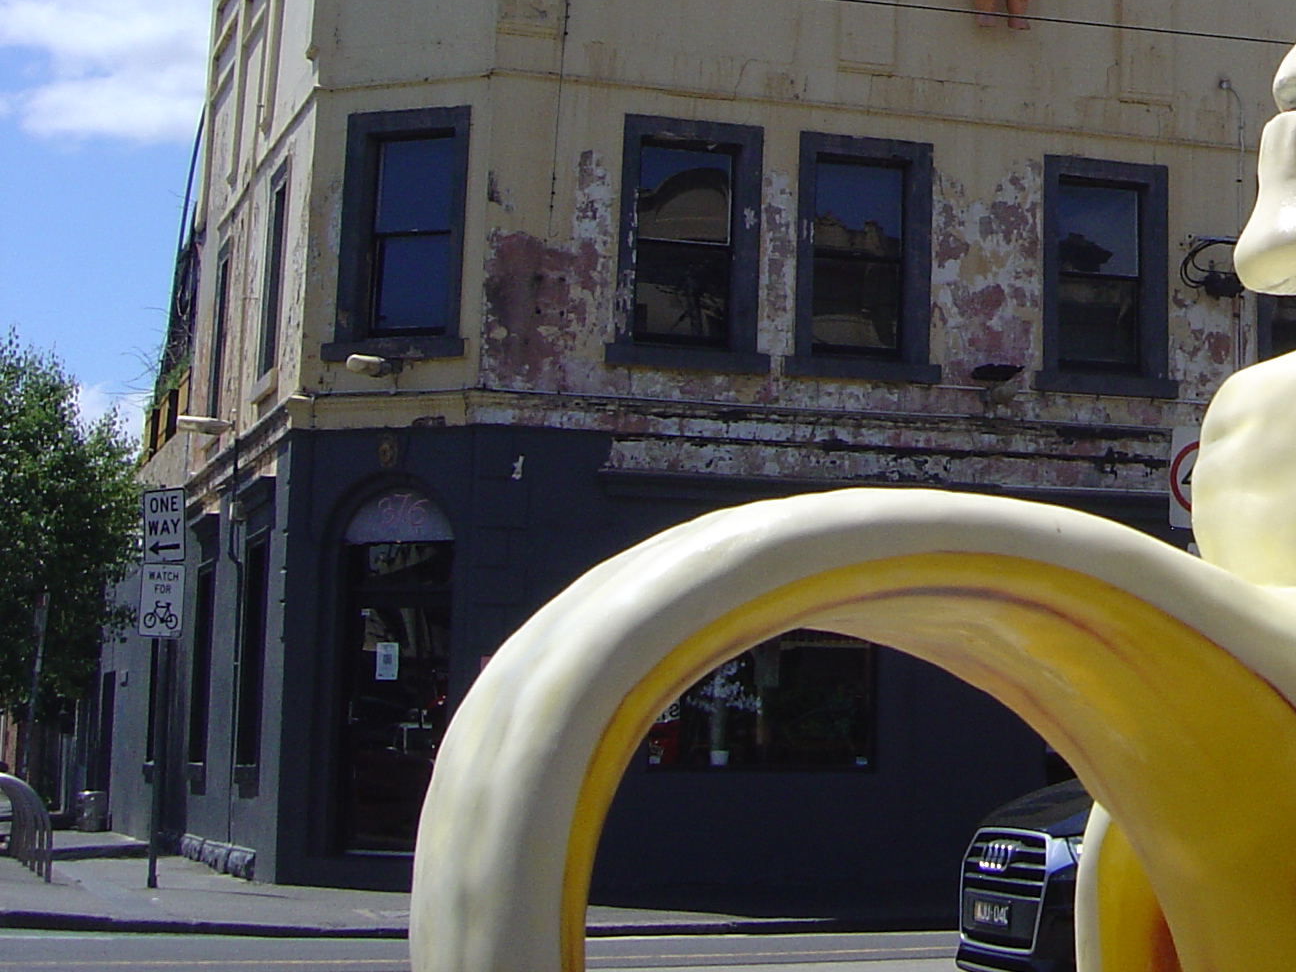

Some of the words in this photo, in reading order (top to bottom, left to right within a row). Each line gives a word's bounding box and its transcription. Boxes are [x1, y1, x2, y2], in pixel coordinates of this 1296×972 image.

[150, 496, 179, 513] ONE
[149, 518, 180, 536] WAY
[149, 571, 179, 582] WATCH
[154, 584, 172, 595] FOR
